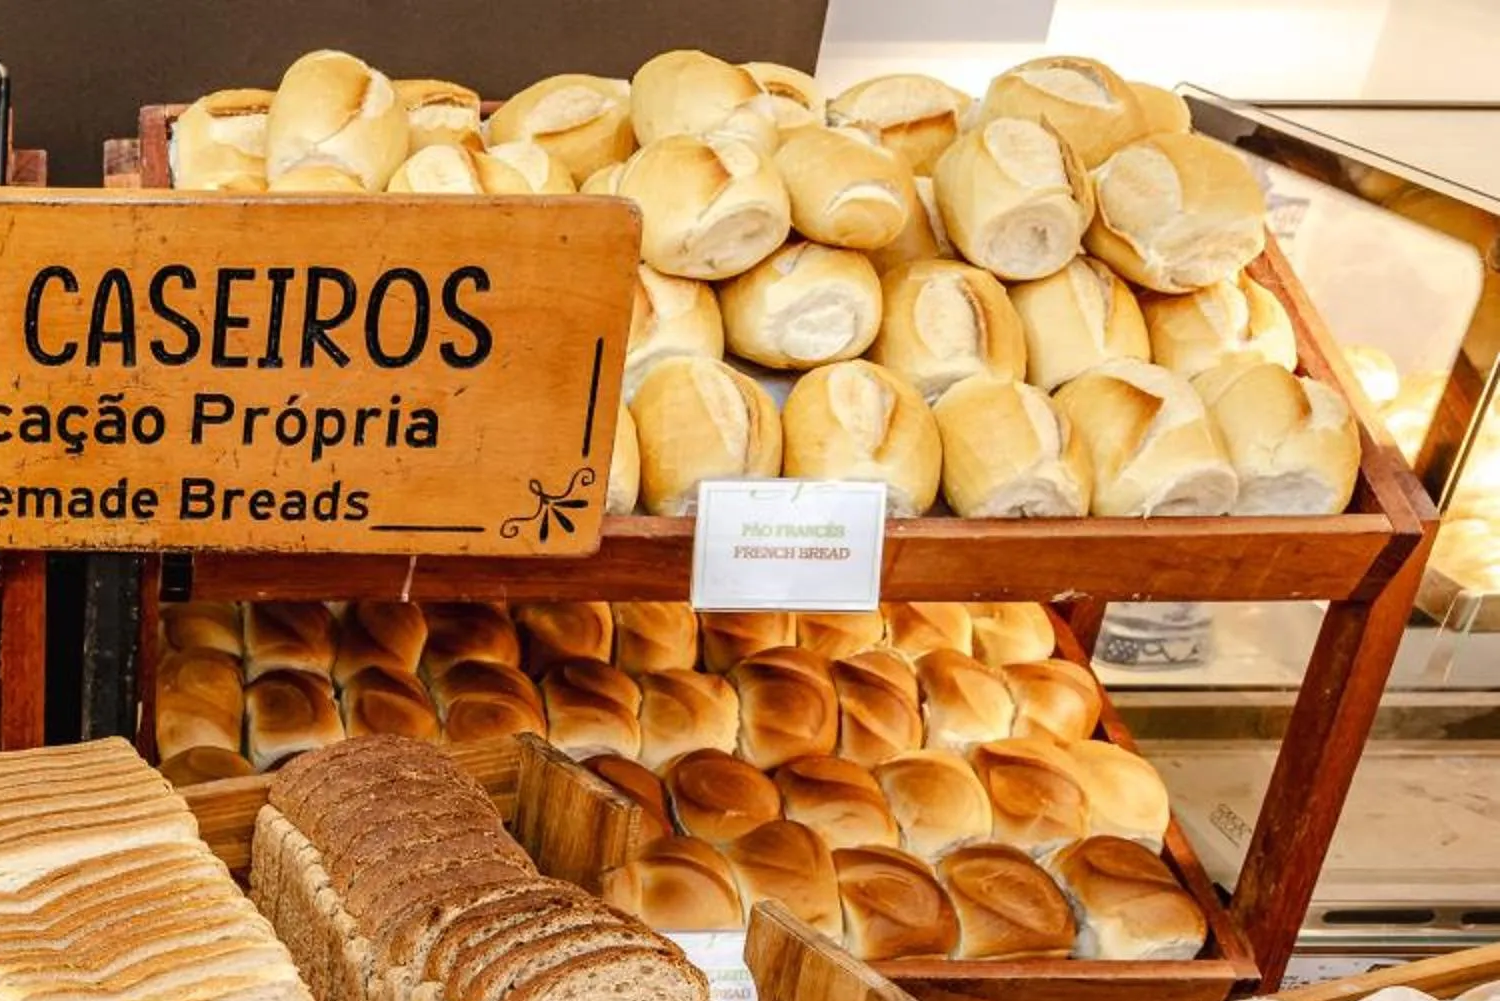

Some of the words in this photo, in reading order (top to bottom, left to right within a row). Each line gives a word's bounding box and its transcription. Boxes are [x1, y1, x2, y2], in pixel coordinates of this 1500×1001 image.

[25, 264, 493, 370] CASEIROS
[190, 392, 441, 461] Própria
[180, 477, 370, 522] Breads
[733, 545, 795, 560] FRENCH
[798, 546, 851, 561] BREAD
